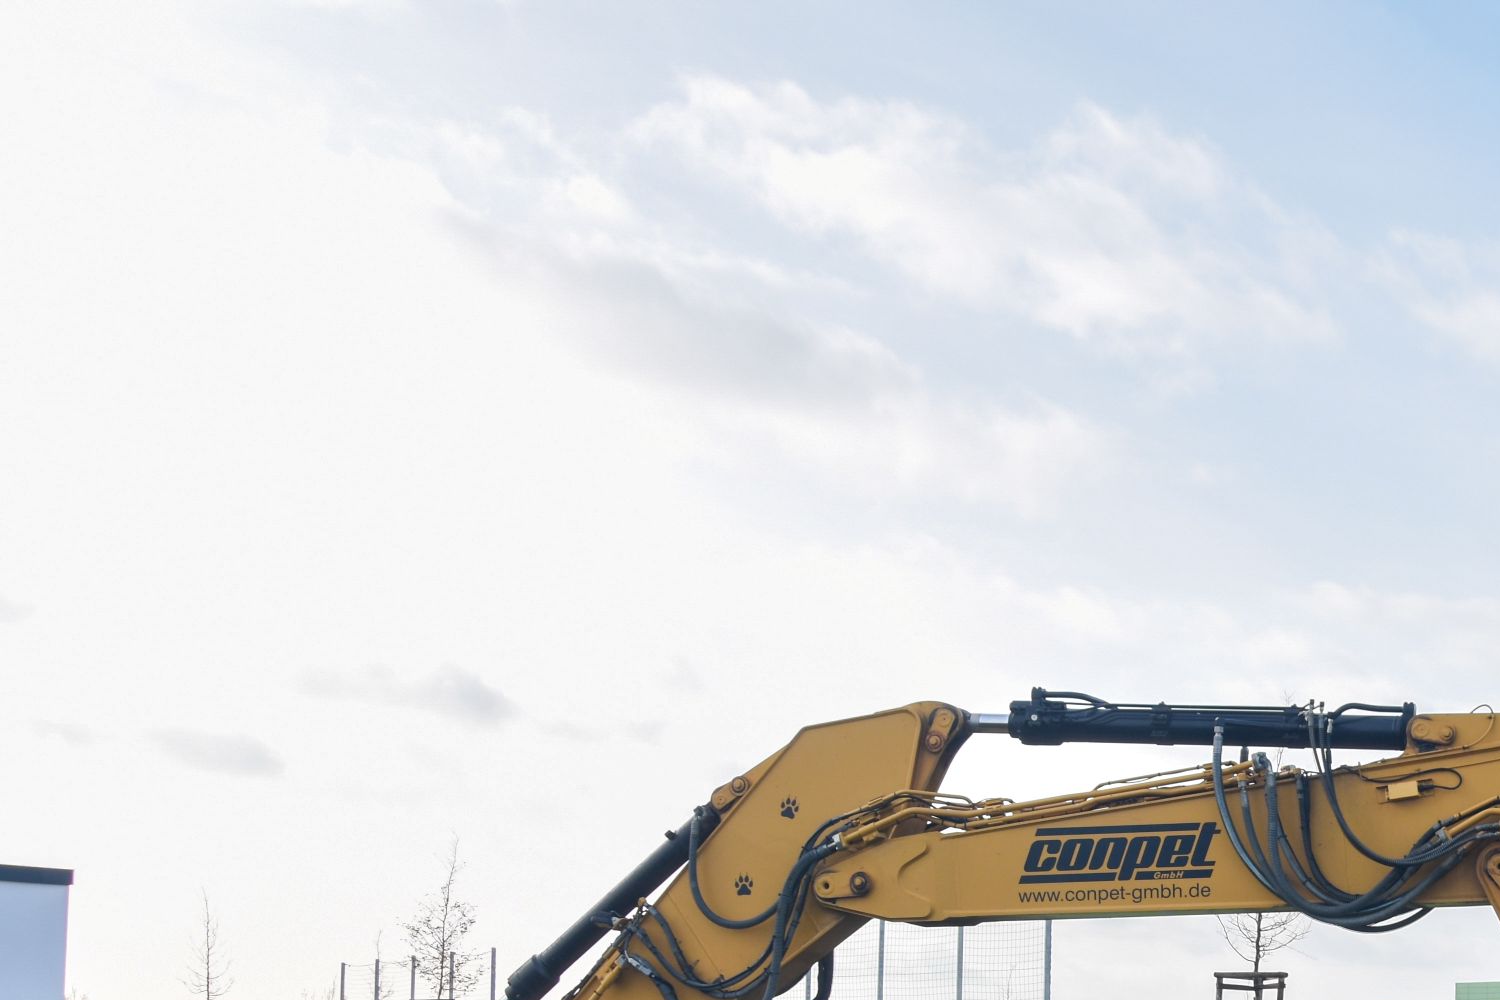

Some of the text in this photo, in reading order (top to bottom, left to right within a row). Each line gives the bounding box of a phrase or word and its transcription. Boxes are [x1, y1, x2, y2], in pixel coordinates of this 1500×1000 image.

[1024, 822, 1221, 881] conpet
[1153, 870, 1184, 880] GmbH
[1019, 883, 1211, 904] www.conpet-gmbh.de
